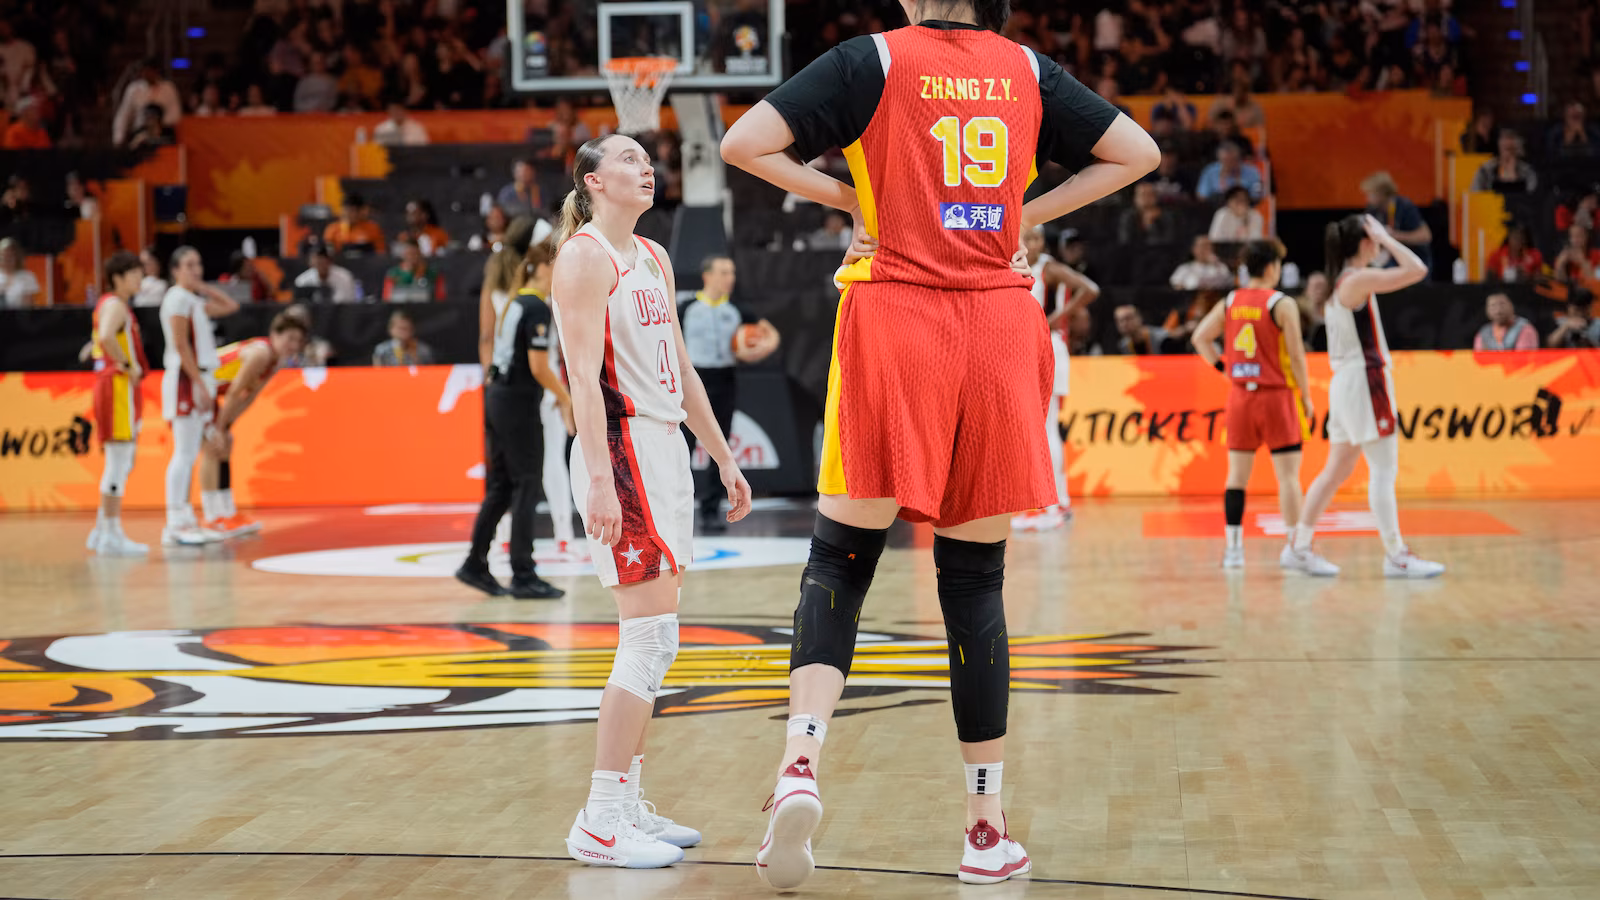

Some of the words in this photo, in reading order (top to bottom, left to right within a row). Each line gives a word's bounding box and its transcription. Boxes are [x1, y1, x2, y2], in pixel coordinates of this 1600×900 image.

[919, 76, 980, 100] ZHANG
[984, 78, 1018, 101] Z.Y.
[929, 116, 1009, 187] 19
[970, 206, 1003, 230] 秀域
[632, 288, 671, 326] USA
[1234, 323, 1257, 359] 4
[657, 339, 676, 394] 4
